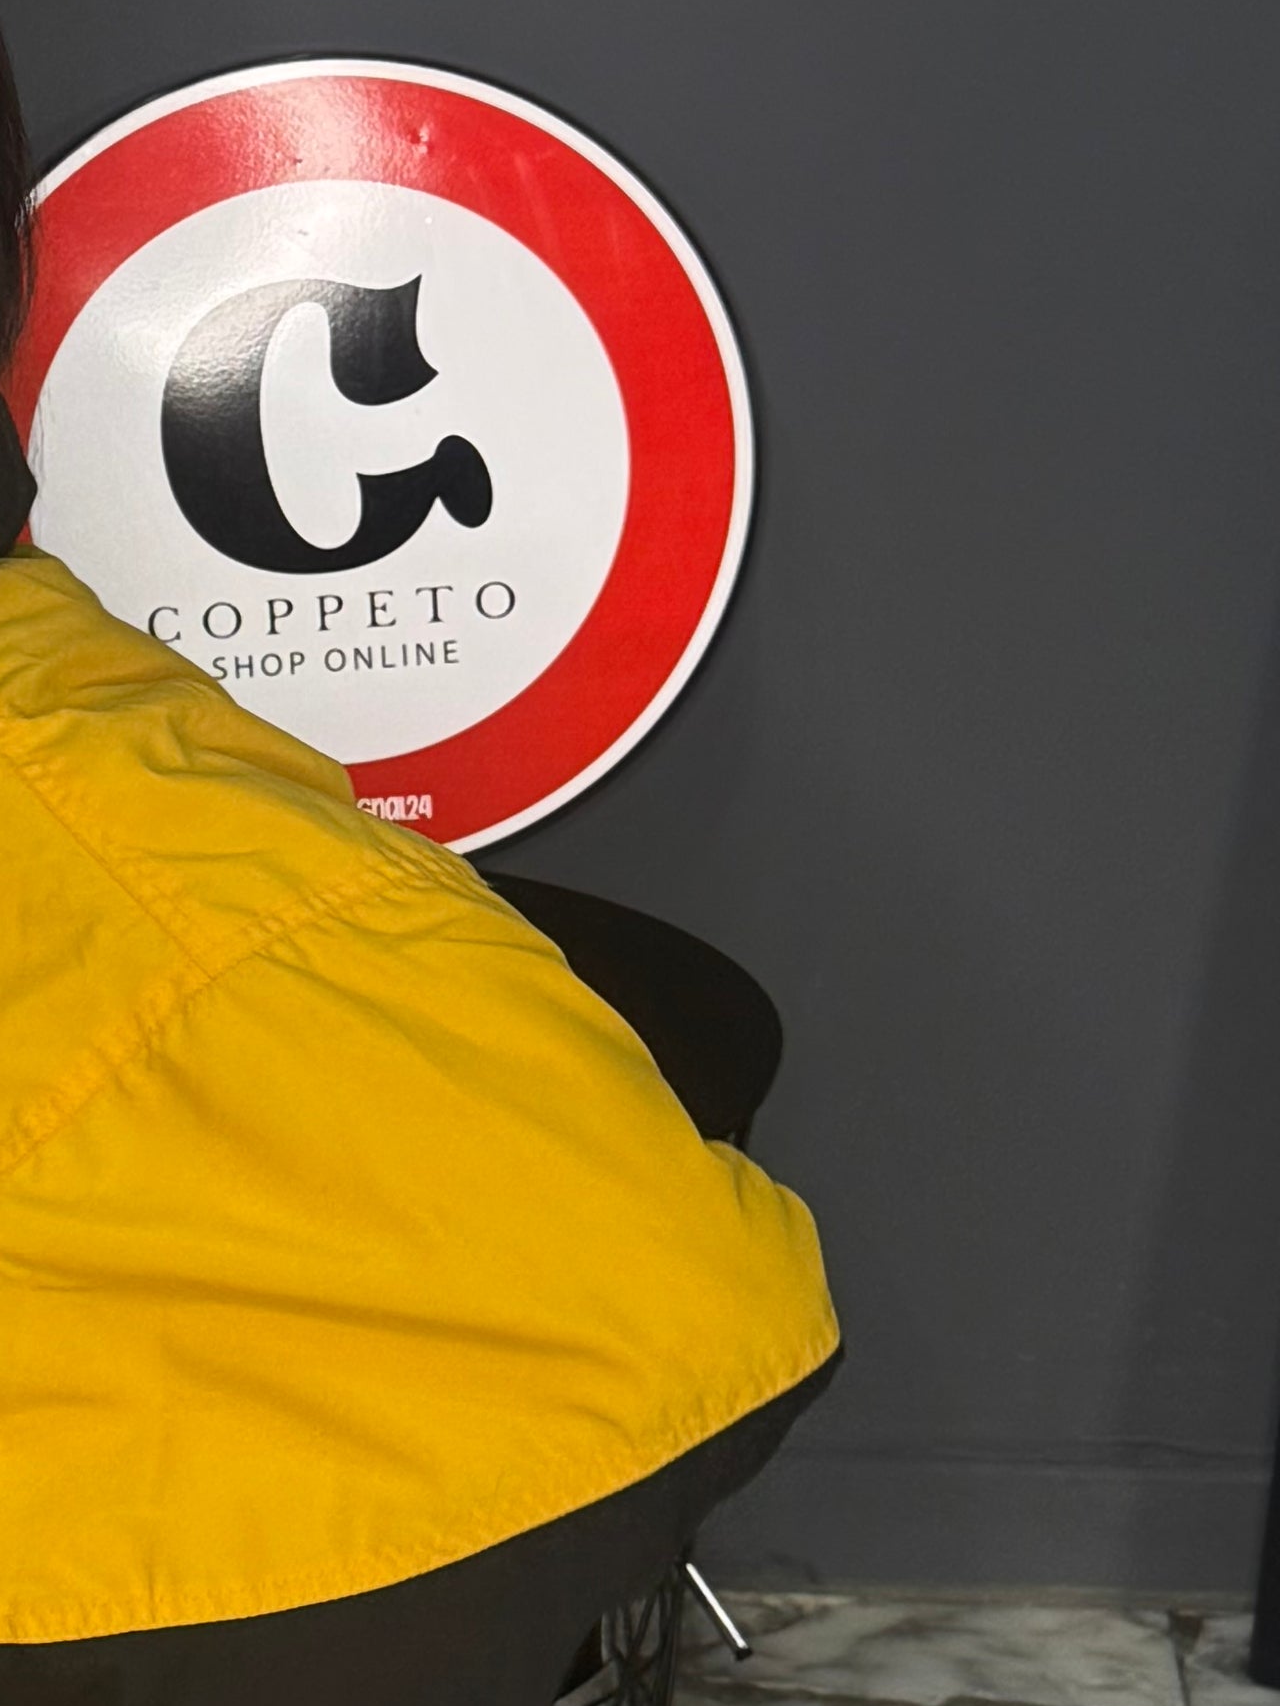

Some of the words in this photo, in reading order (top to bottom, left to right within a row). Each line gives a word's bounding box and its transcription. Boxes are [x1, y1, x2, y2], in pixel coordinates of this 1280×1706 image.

[160, 273, 494, 576] C
[147, 580, 517, 644] COPPETO
[211, 650, 307, 681] SHOP
[324, 639, 461, 673] ONLINE
